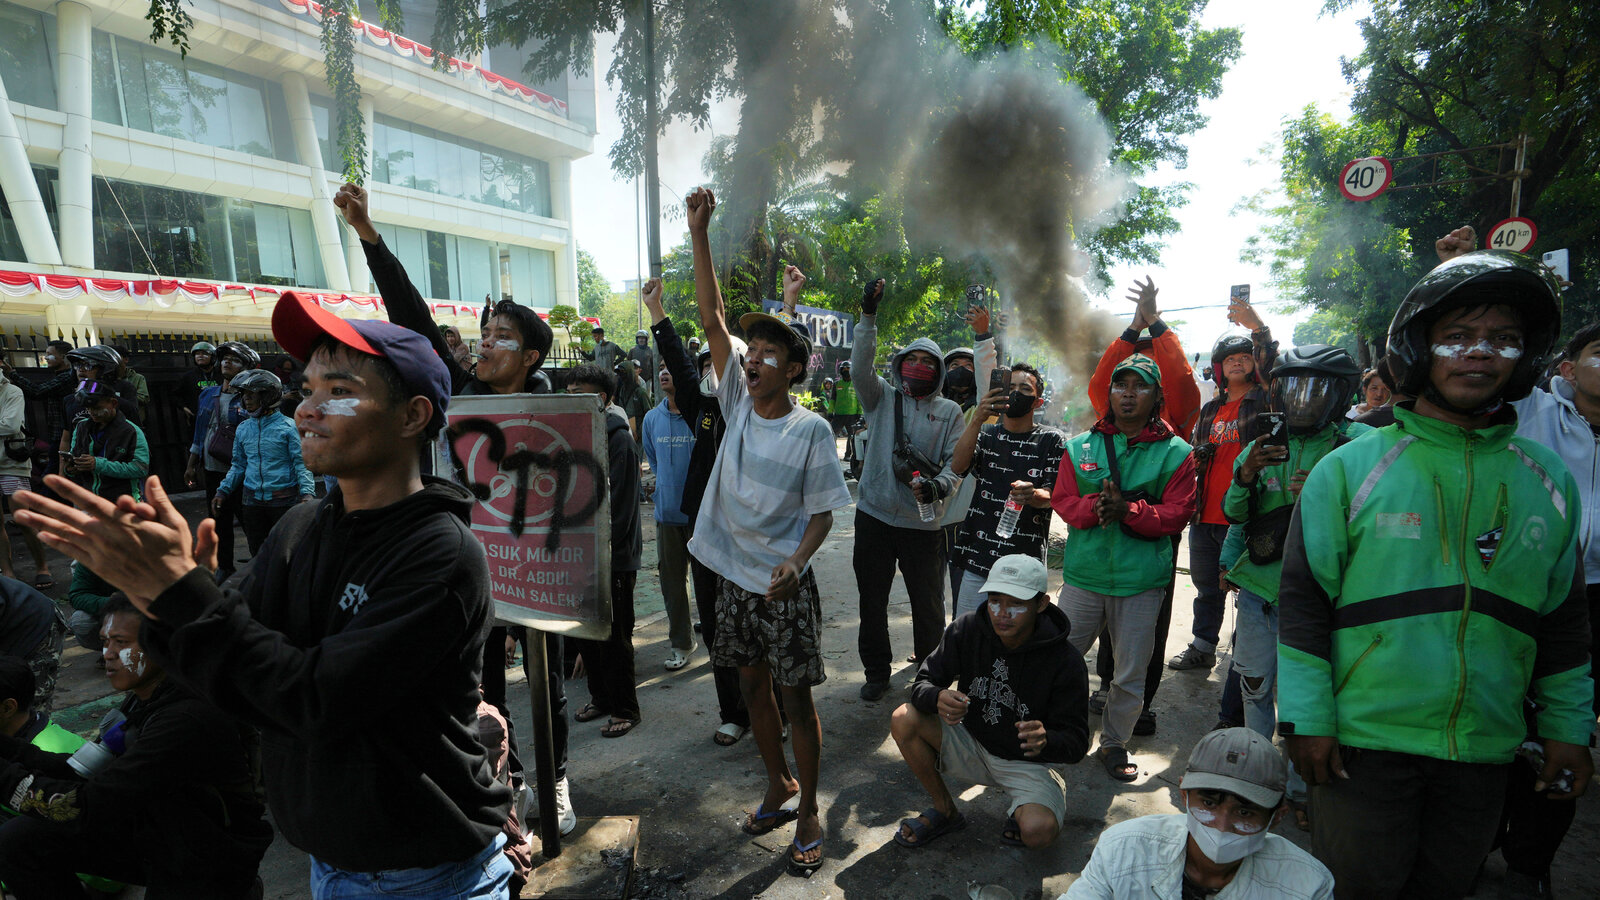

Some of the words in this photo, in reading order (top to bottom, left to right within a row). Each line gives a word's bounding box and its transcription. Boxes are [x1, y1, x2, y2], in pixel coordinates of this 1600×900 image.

[1346, 166, 1374, 189] 40
[1493, 229, 1516, 247] 40
[526, 546, 584, 563] MOTOR
[498, 565, 522, 581] DR.
[527, 570, 573, 586] ABDUL
